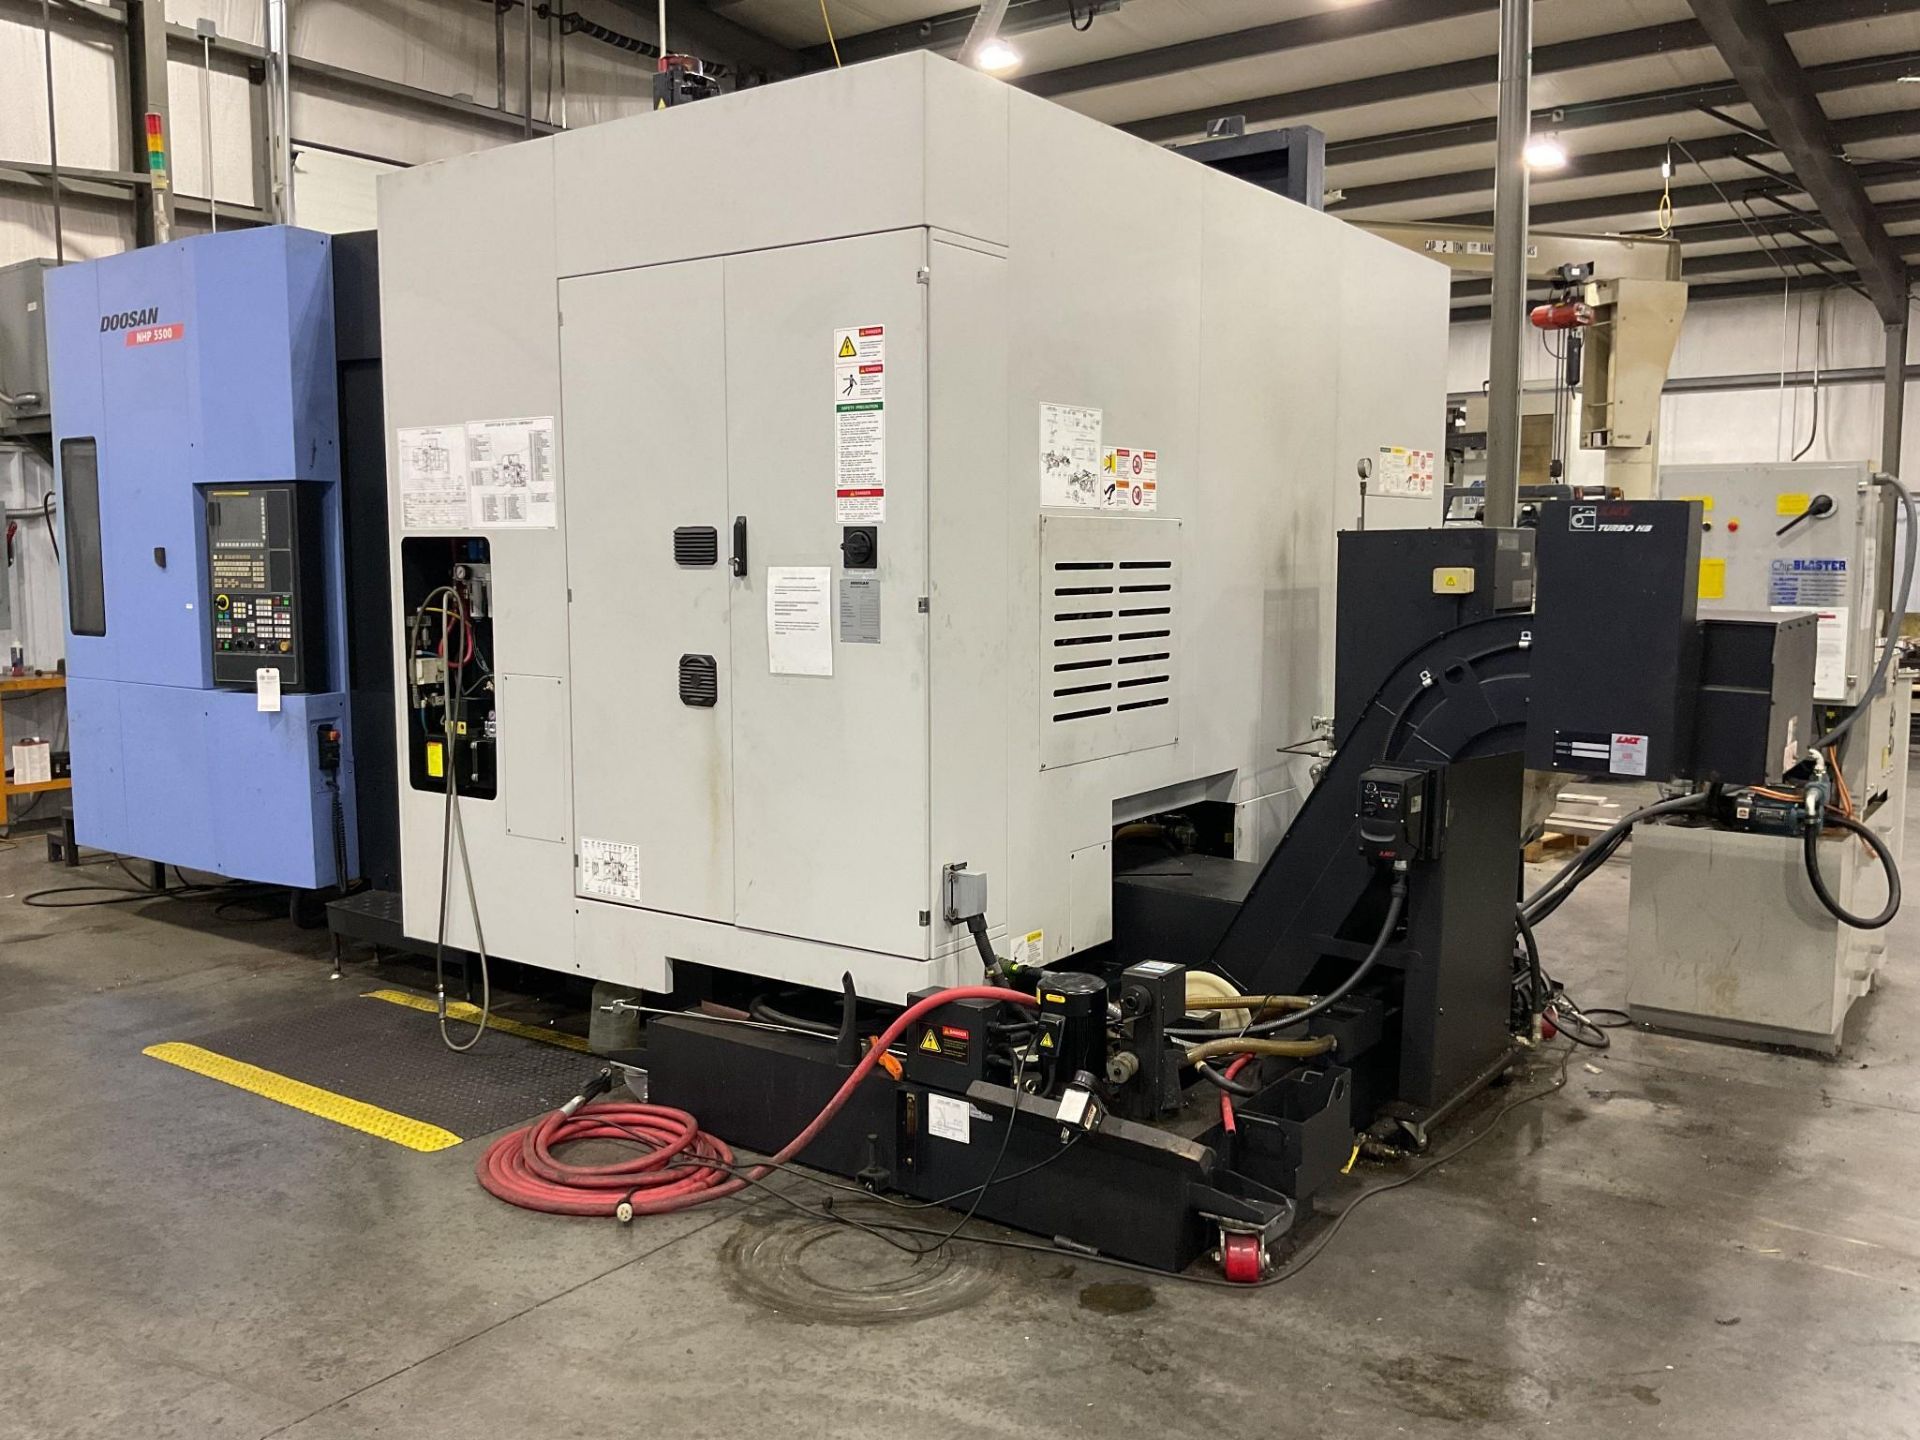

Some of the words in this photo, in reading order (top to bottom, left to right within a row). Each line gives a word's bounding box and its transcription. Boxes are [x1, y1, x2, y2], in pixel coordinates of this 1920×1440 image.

[1424, 240, 1436, 252] CAP
[1442, 240, 1447, 253] 2
[100, 307, 159, 333] DOOSAN
[136, 331, 152, 343] NHP
[154, 328, 173, 341] 5500
[1598, 524, 1635, 532] TURBO
[1771, 560, 1847, 572] ChipBLASTER
